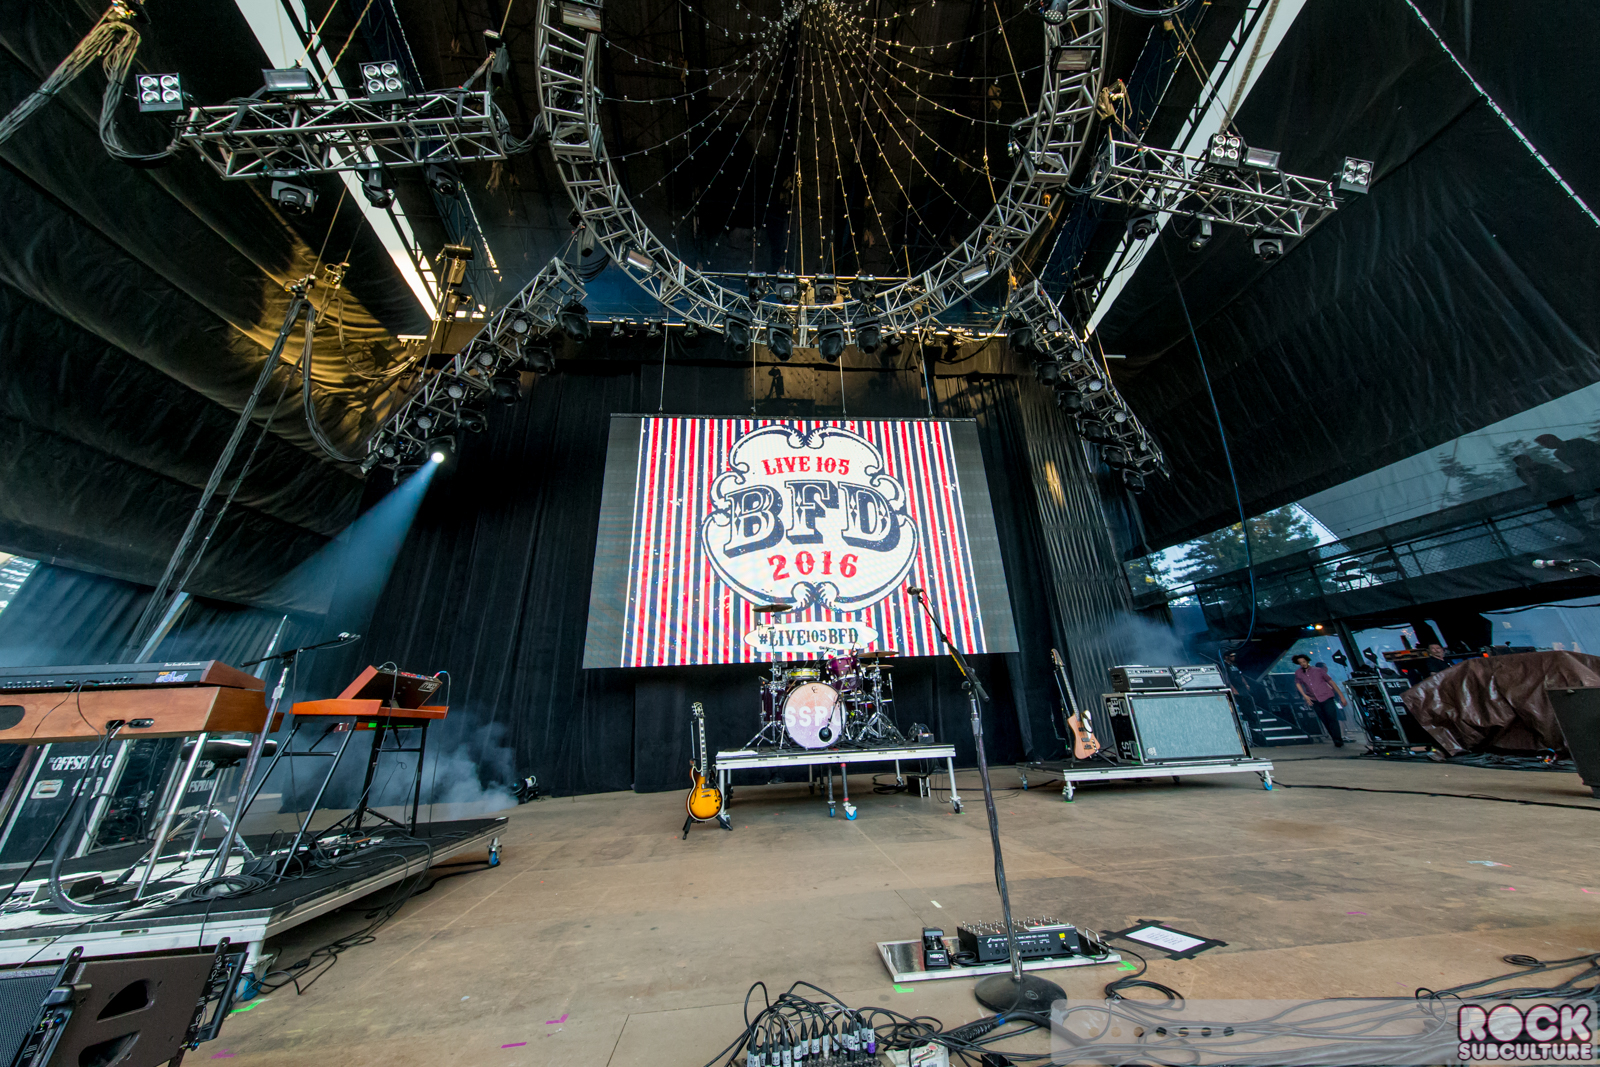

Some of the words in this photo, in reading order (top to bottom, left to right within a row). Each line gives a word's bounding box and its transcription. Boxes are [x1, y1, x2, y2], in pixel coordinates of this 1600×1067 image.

[761, 456, 810, 475] LIVE
[816, 456, 850, 475] 105
[723, 480, 901, 559] BFD
[767, 551, 859, 581] 2016
